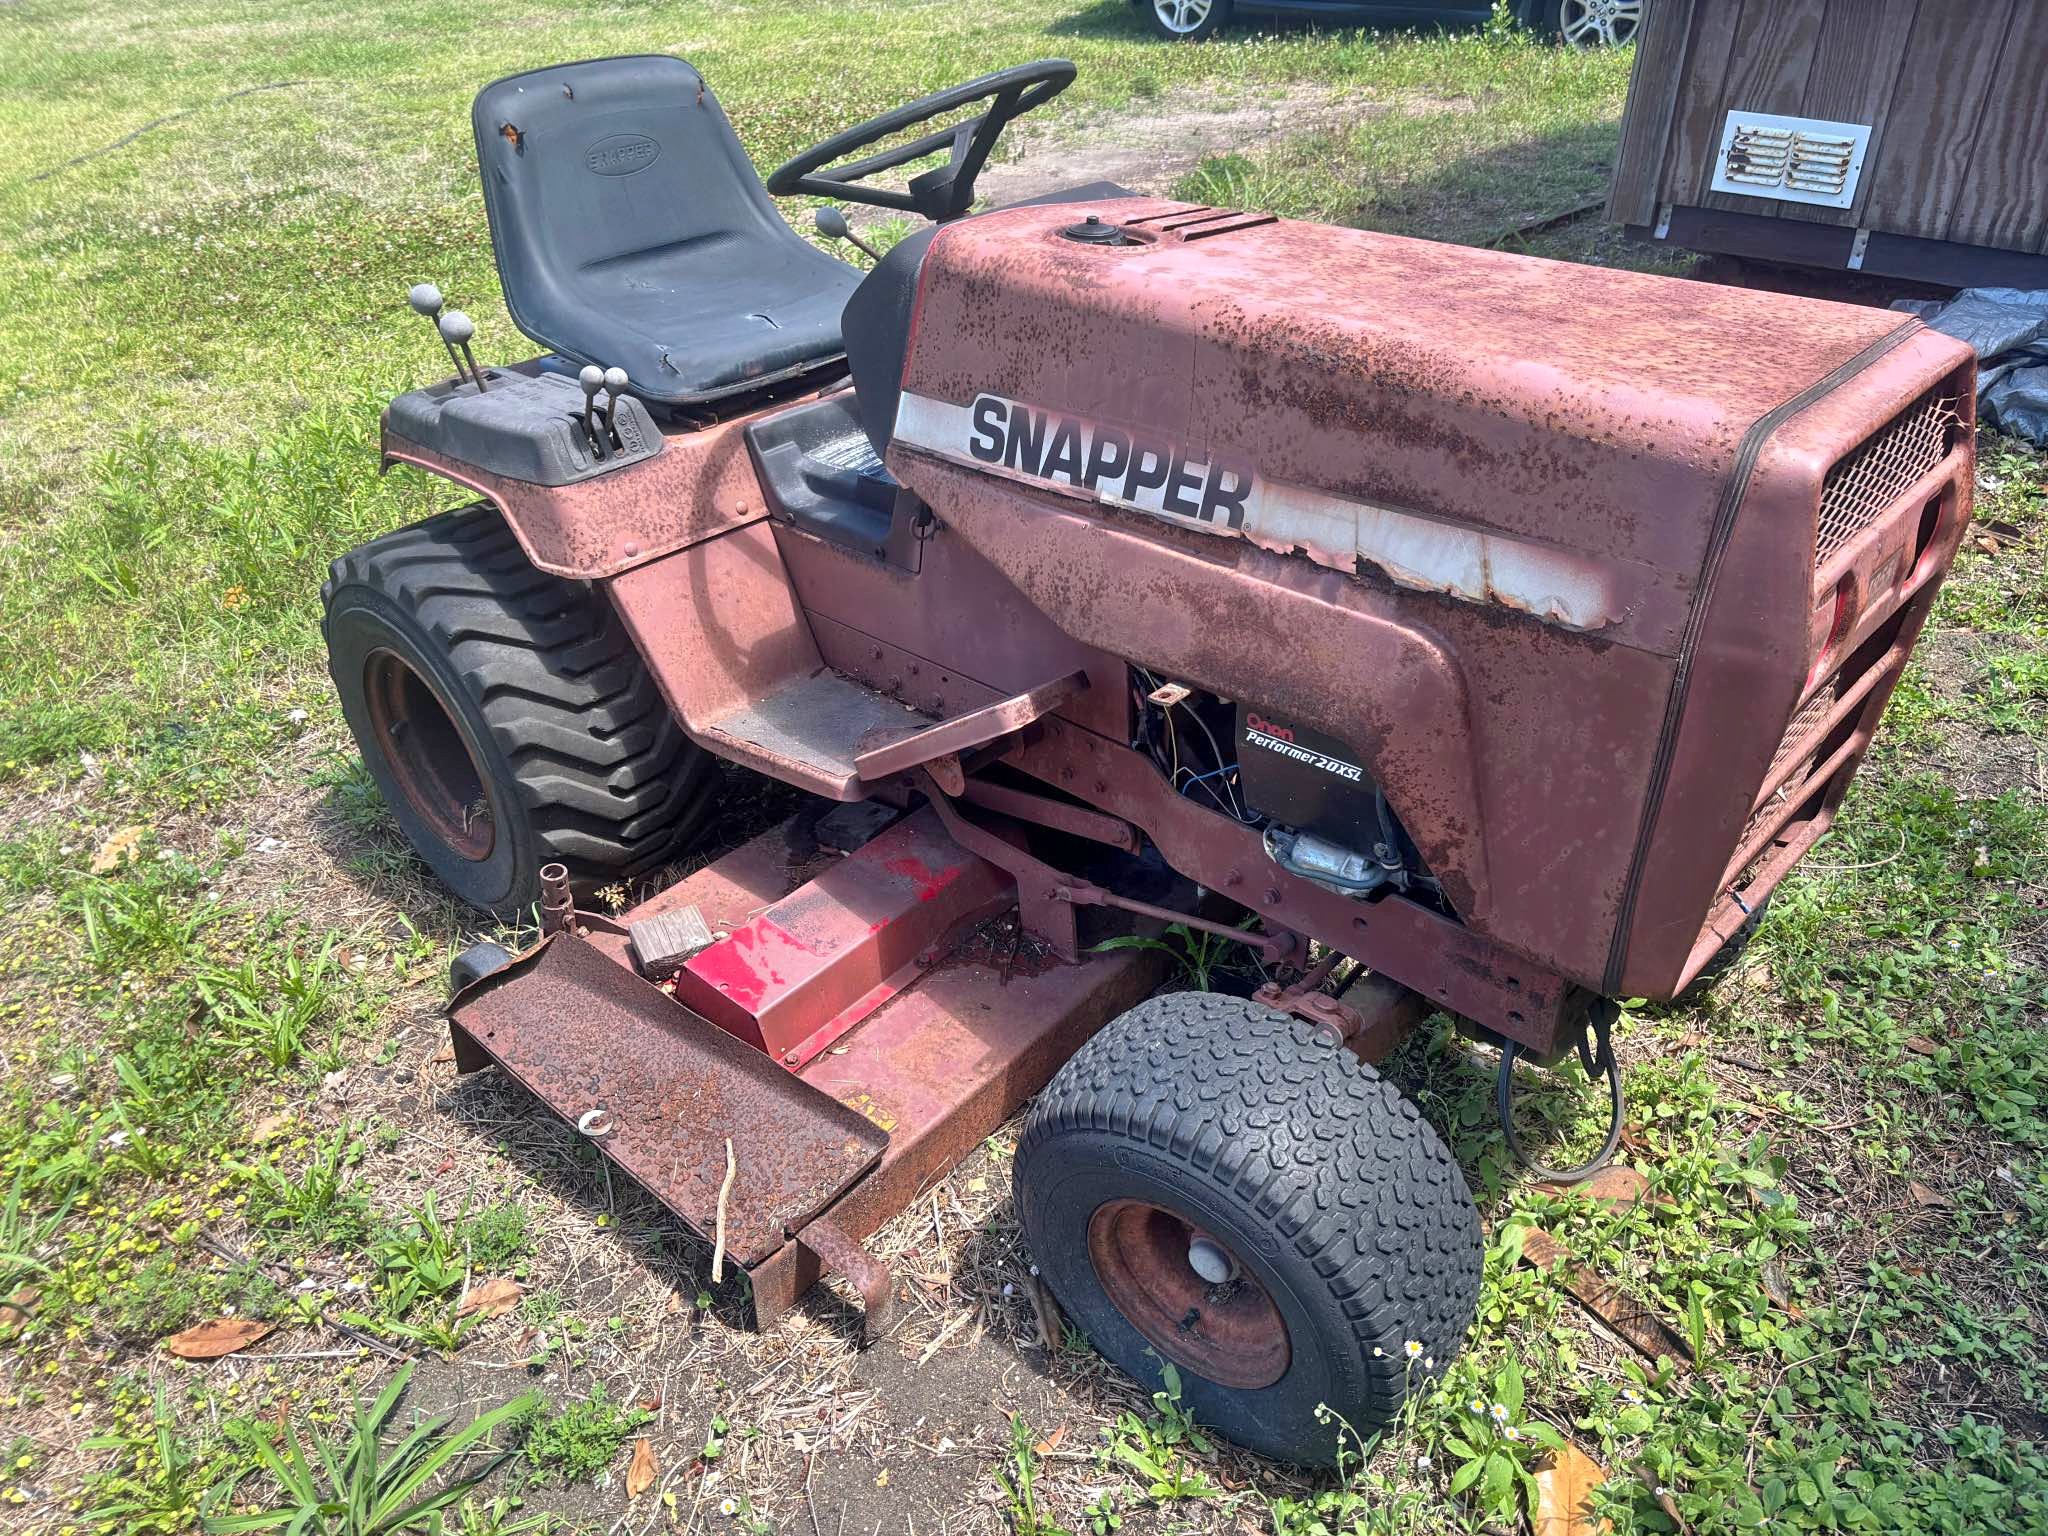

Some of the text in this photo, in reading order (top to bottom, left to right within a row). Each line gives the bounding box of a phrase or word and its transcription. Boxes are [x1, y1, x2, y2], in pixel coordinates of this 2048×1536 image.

[588, 141, 653, 168] SNAPPER
[969, 397, 1251, 529] SNAPPER
[1247, 713, 1294, 742] Onan
[1246, 731, 1361, 782] Performer 20XSL
